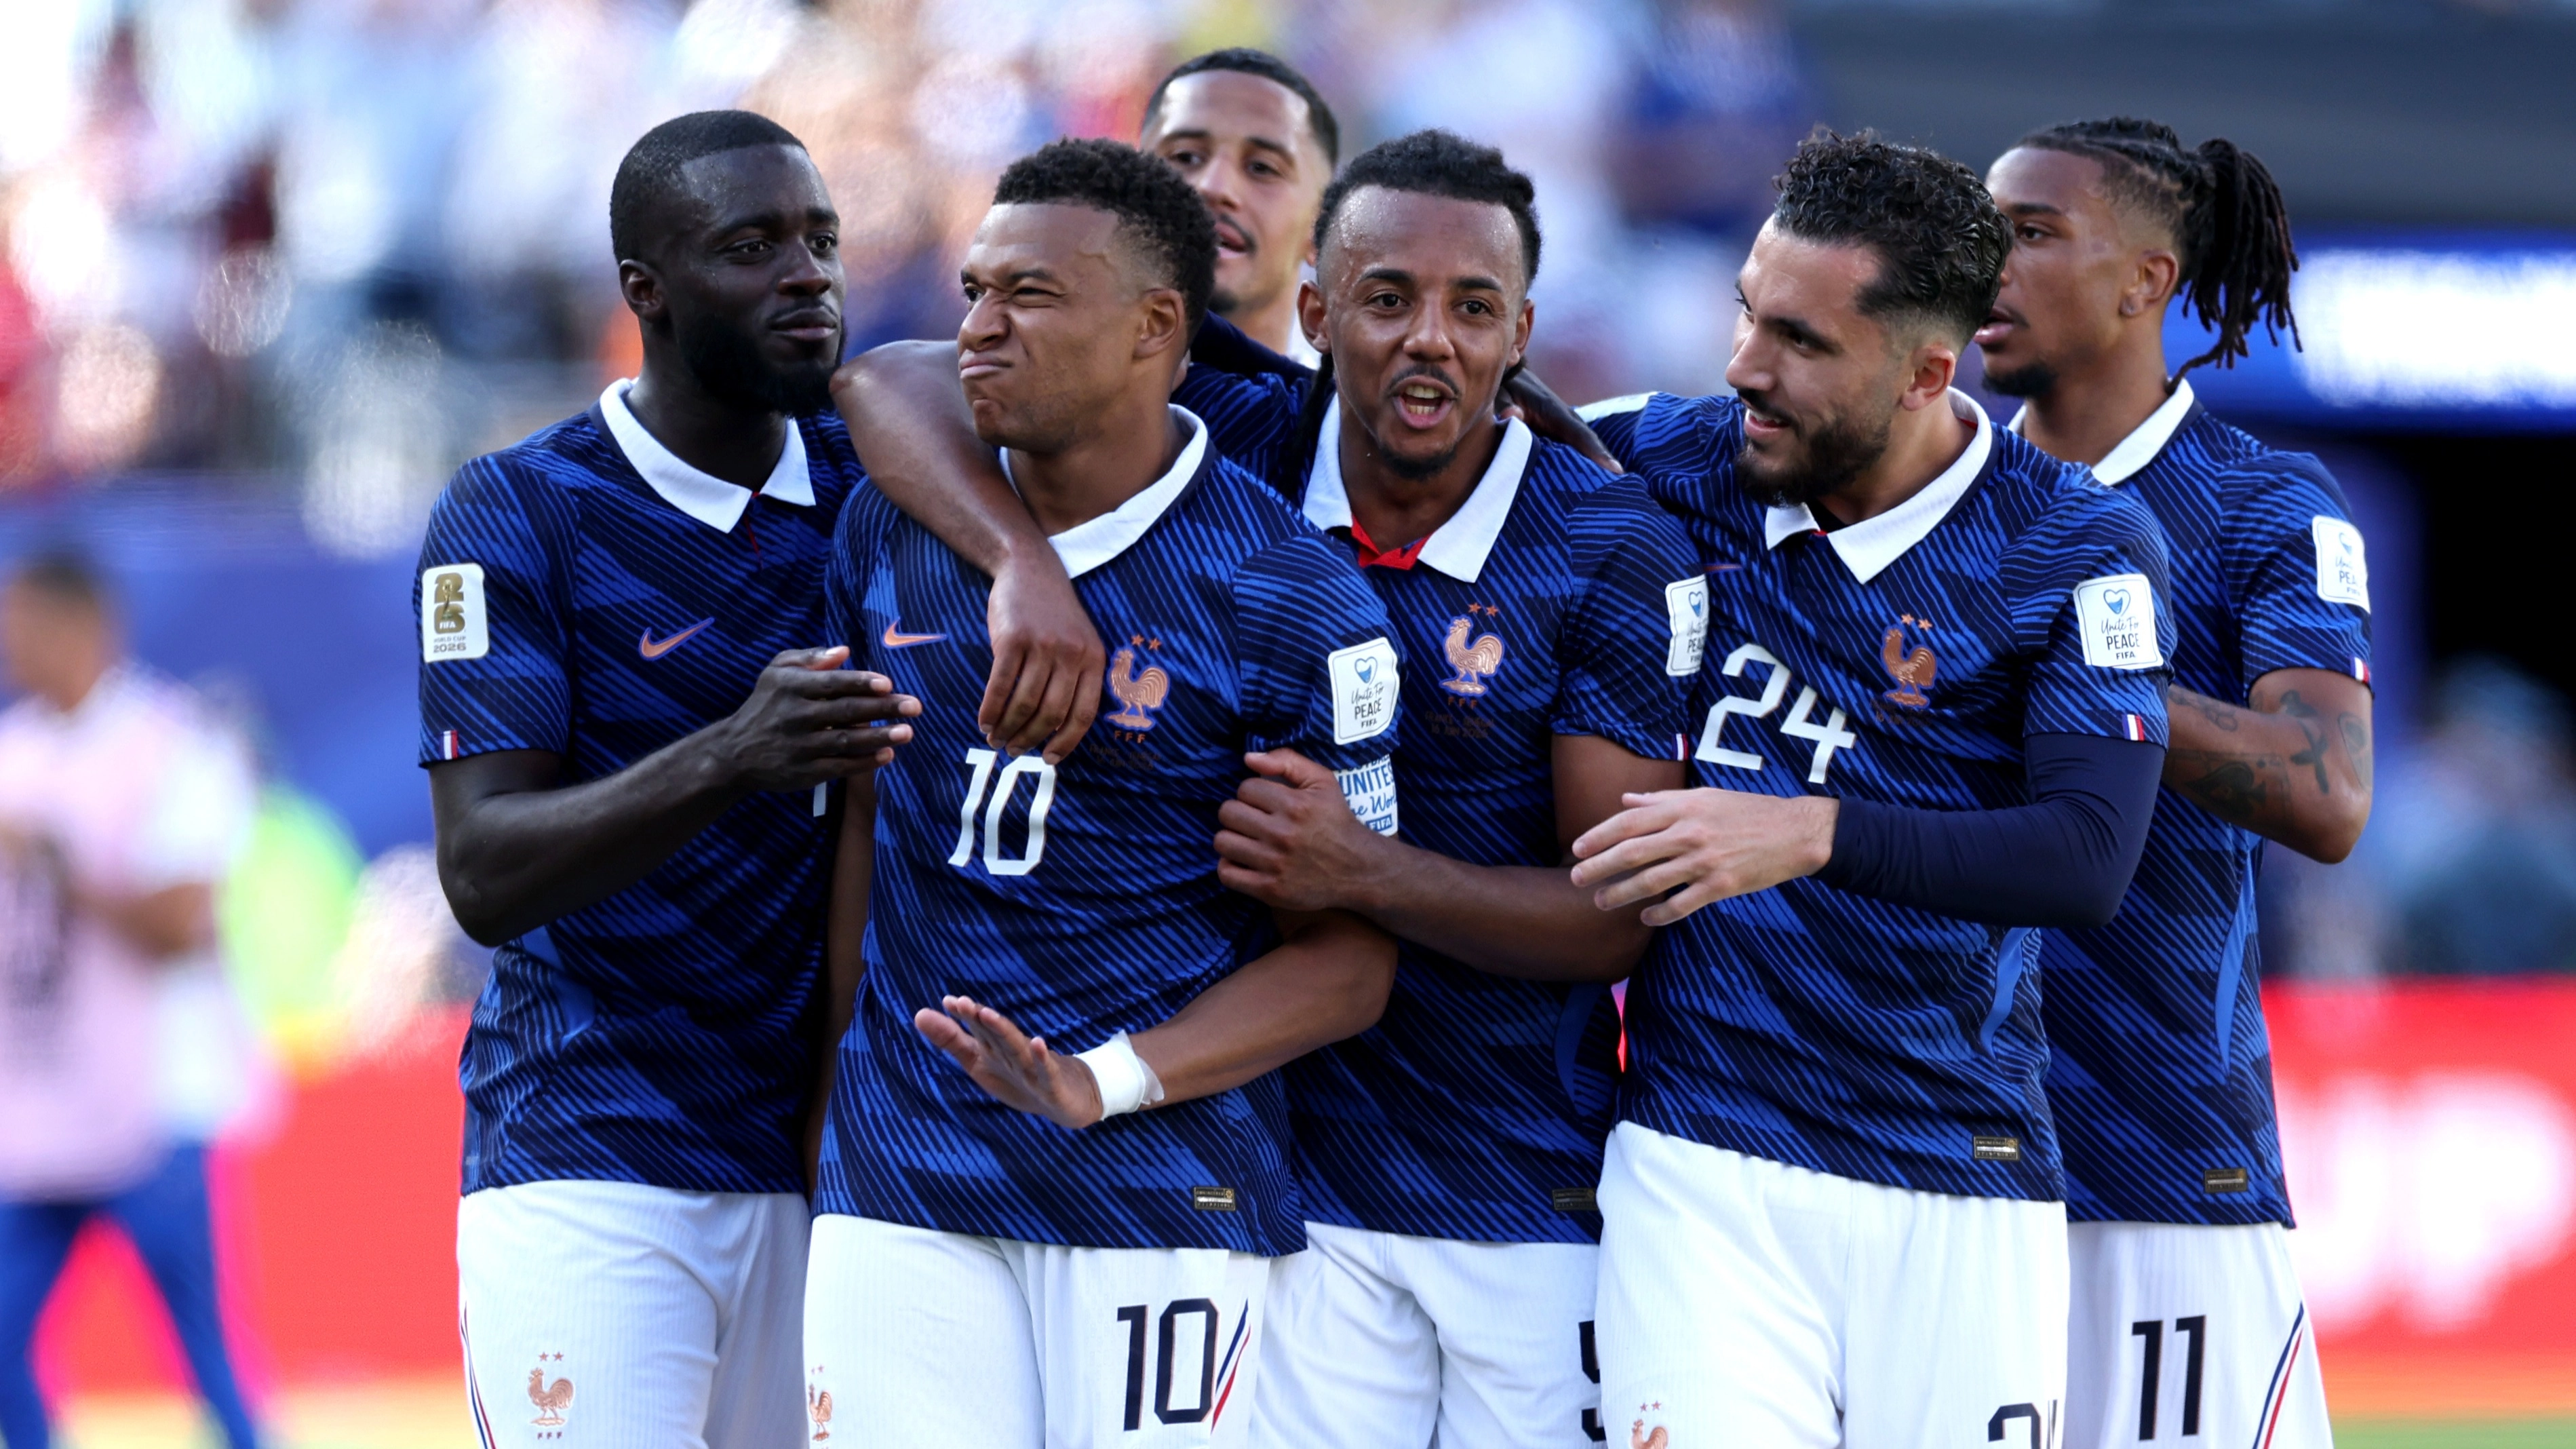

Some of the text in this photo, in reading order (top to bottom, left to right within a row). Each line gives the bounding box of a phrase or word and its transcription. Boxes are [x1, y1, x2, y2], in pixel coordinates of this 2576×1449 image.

[439, 621, 456, 630] FIFA
[2101, 616, 2139, 635] Unite For
[433, 642, 466, 653] 2026
[2106, 633, 2140, 651] PEACE
[2115, 651, 2136, 660] FIFA
[1351, 682, 1384, 704] Unite For
[1354, 697, 1382, 720] PEACE
[1695, 642, 1856, 784] 24
[1361, 718, 1378, 728] FIFA
[948, 748, 1057, 876] 10
[1117, 1298, 1218, 1431] 10
[2132, 1315, 2206, 1441] 11
